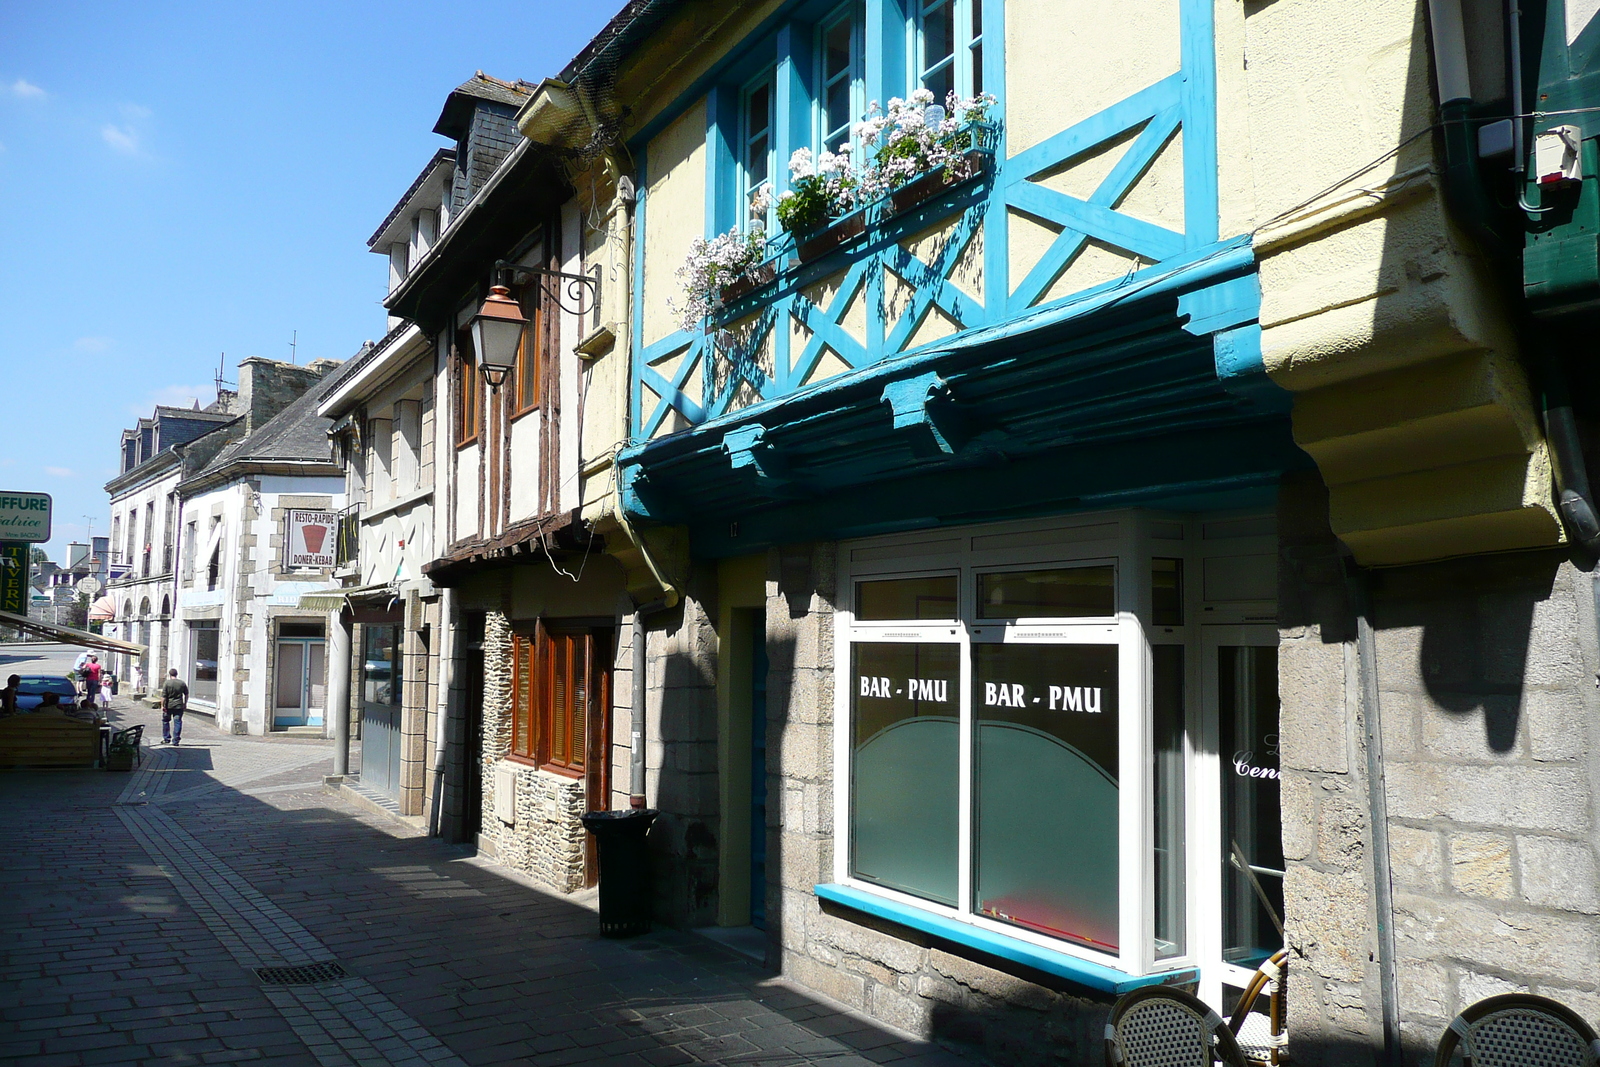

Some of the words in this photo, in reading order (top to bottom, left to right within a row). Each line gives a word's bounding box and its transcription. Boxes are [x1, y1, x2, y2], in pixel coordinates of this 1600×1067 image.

[295, 513, 334, 524] RESTO-RAPIDE
[294, 555, 333, 565] DONER-KEBAB
[5, 547, 21, 612] TAVERN
[860, 676, 891, 698] BAR
[908, 679, 948, 702] PMU
[985, 682, 1026, 708] BAR
[1049, 685, 1101, 713] PMU
[1263, 734, 1280, 756] L
